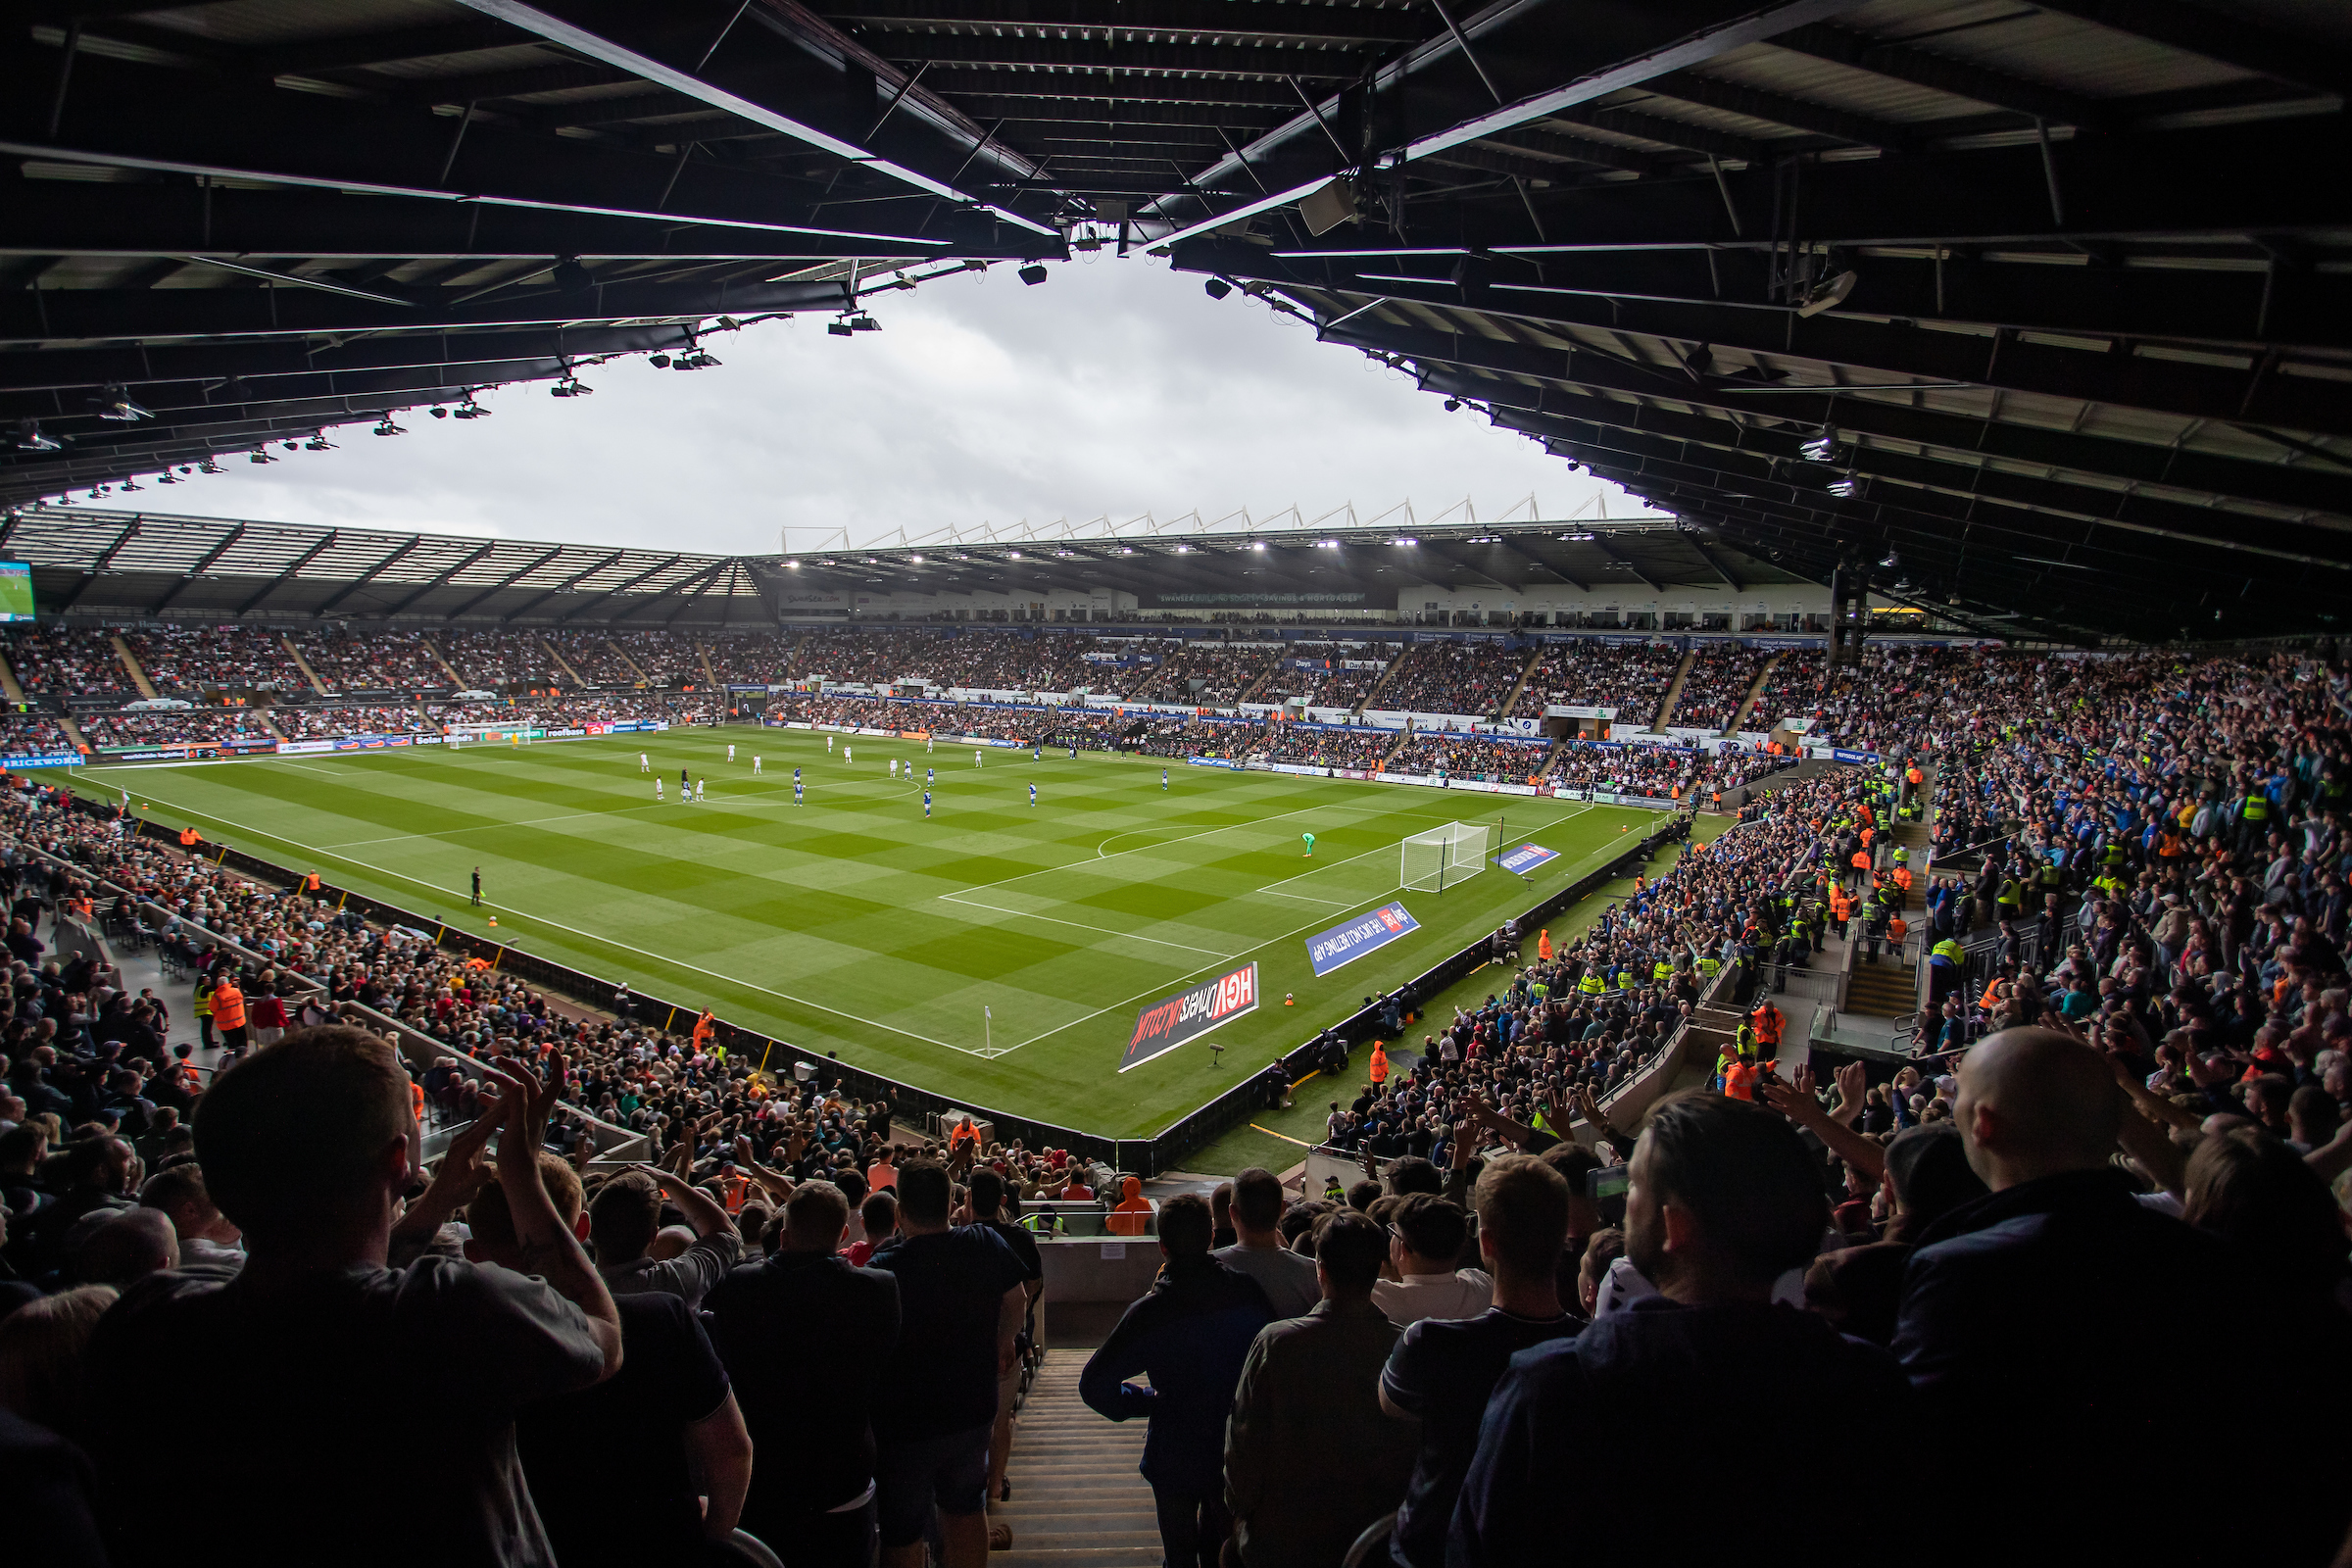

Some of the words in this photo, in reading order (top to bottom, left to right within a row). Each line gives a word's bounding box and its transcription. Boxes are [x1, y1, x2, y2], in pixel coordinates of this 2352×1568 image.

[102, 619, 135, 629] Luxury
[416, 736, 442, 745] Solar
[444, 734, 473, 743] Blinds
[548, 727, 585, 737] roofbase
[1381, 912, 1400, 929] bet
[1390, 907, 1409, 924] sky
[1368, 917, 1386, 934] THE
[1323, 933, 1351, 956] BETTING
[1346, 928, 1363, 946] NO.1
[1312, 943, 1327, 962] APP
